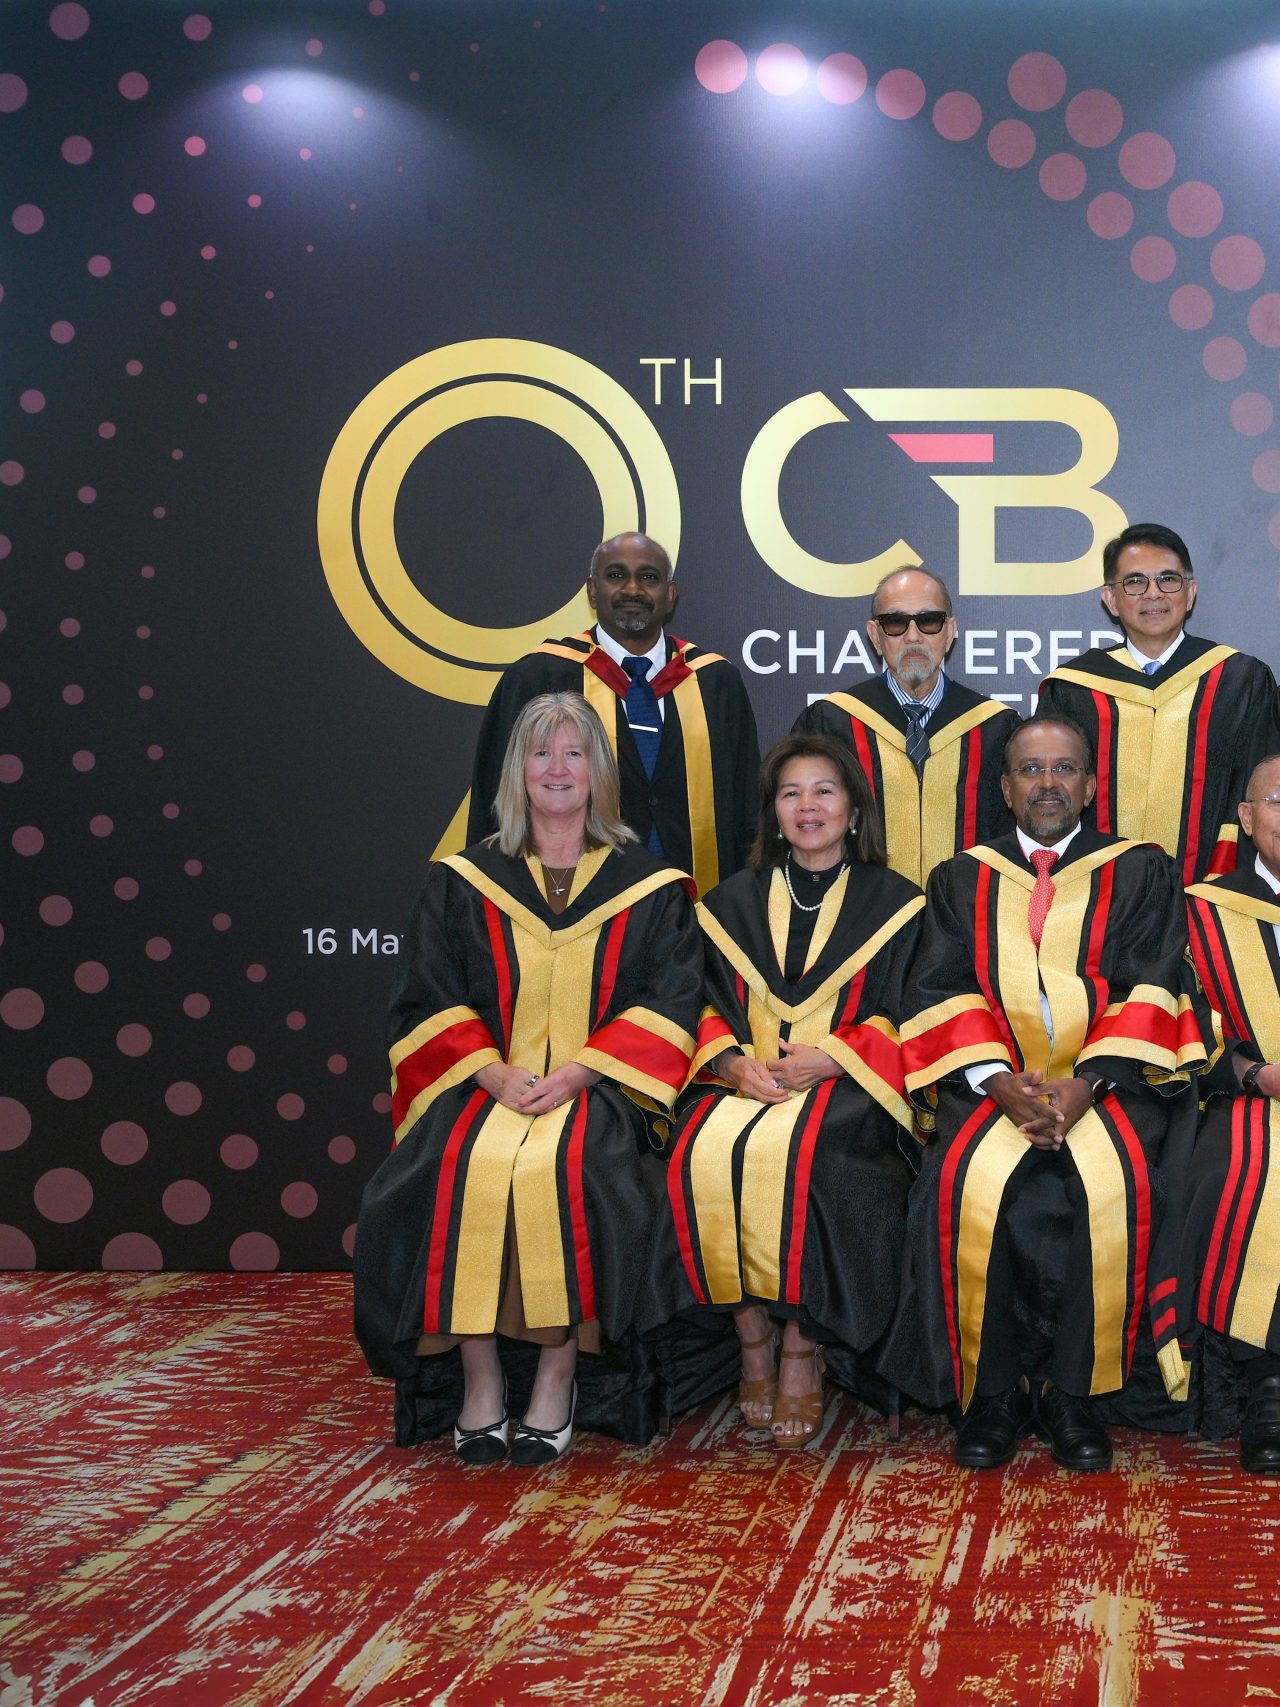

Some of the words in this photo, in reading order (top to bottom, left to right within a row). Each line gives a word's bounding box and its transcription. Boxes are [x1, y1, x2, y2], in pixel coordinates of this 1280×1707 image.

[741, 629, 1125, 675] CHAERE
[302, 927, 338, 955] 16
[351, 927, 405, 955] Ma
